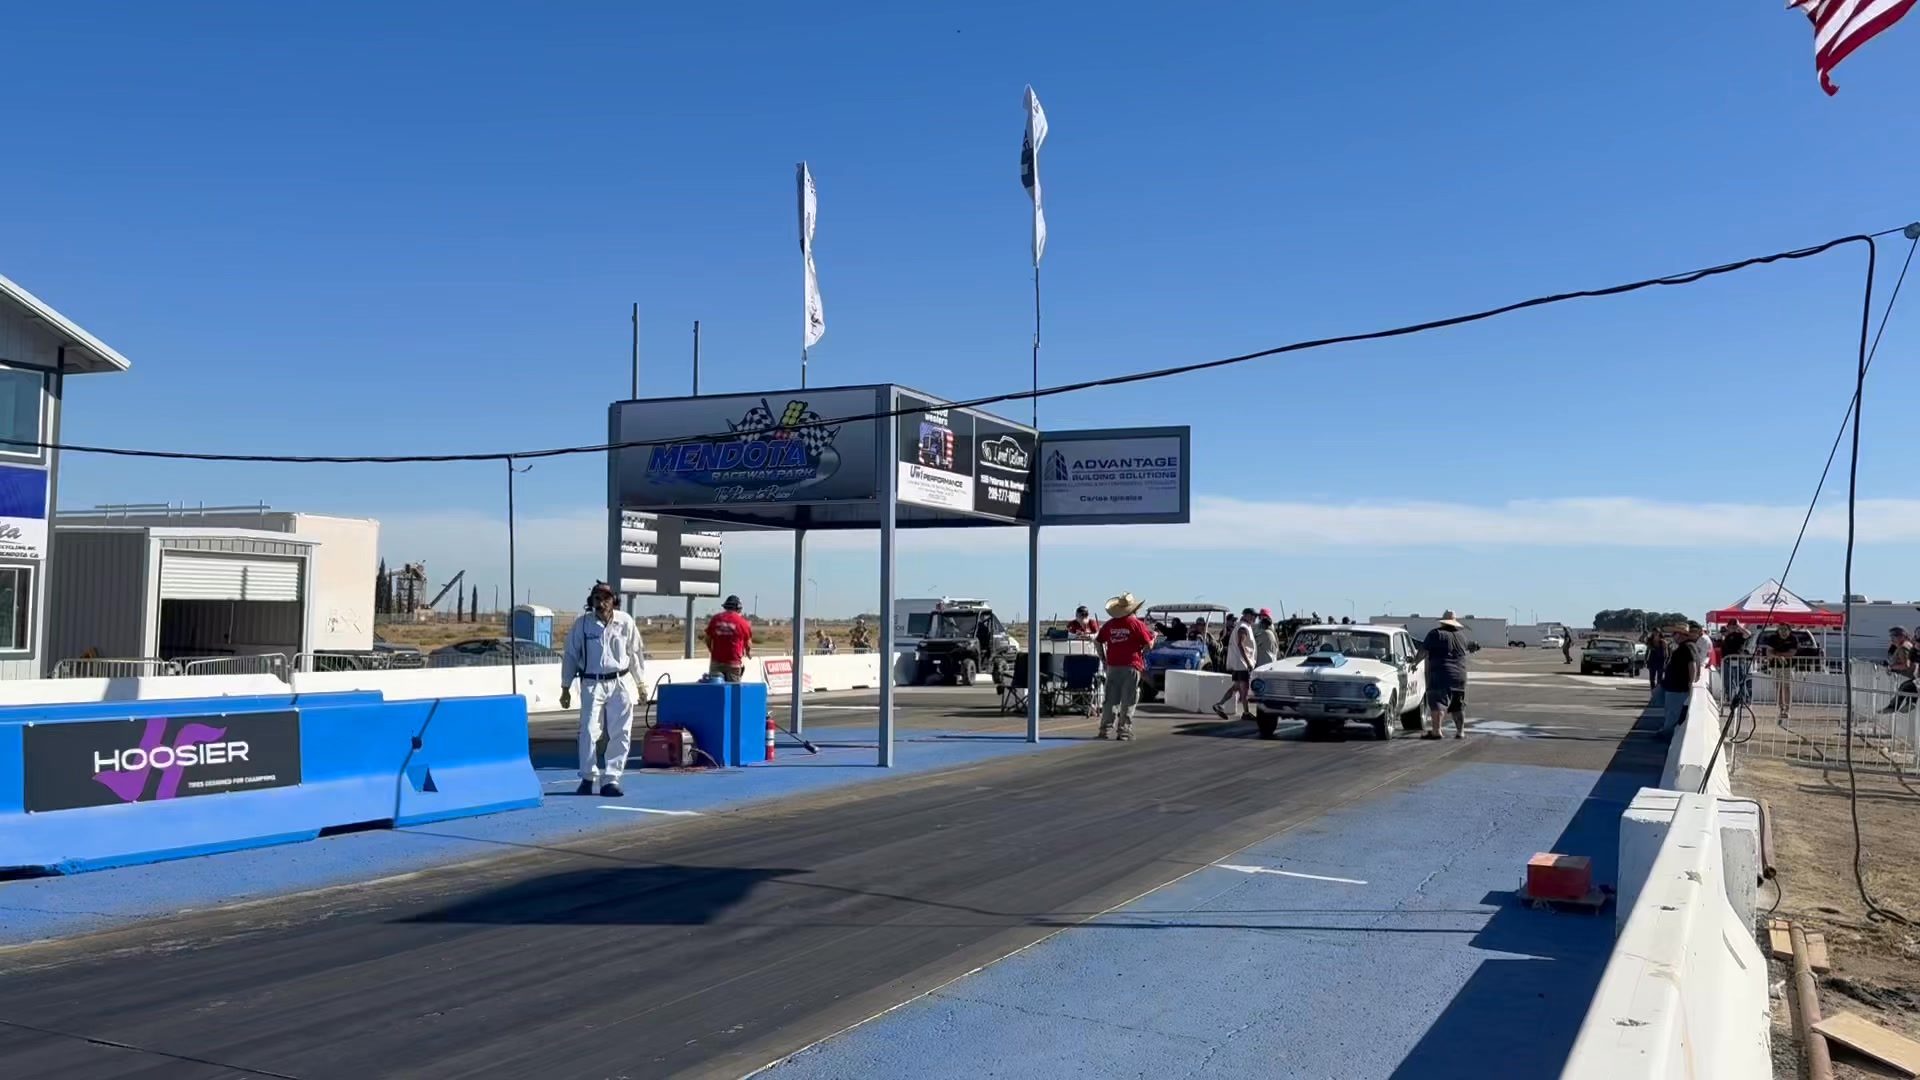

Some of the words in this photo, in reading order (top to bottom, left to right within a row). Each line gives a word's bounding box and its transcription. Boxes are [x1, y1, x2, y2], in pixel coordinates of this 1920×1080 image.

[648, 440, 807, 472] MENDOTA
[1072, 457, 1178, 470] ADVANTAGE
[711, 470, 773, 481] RACEWAY
[776, 468, 816, 479] PARK
[923, 473, 963, 488] PERFORMANCE
[1072, 473, 1116, 481] BUILDING
[1119, 471, 1177, 480] SOLUTIONS
[94, 741, 249, 773] HOOSIER
